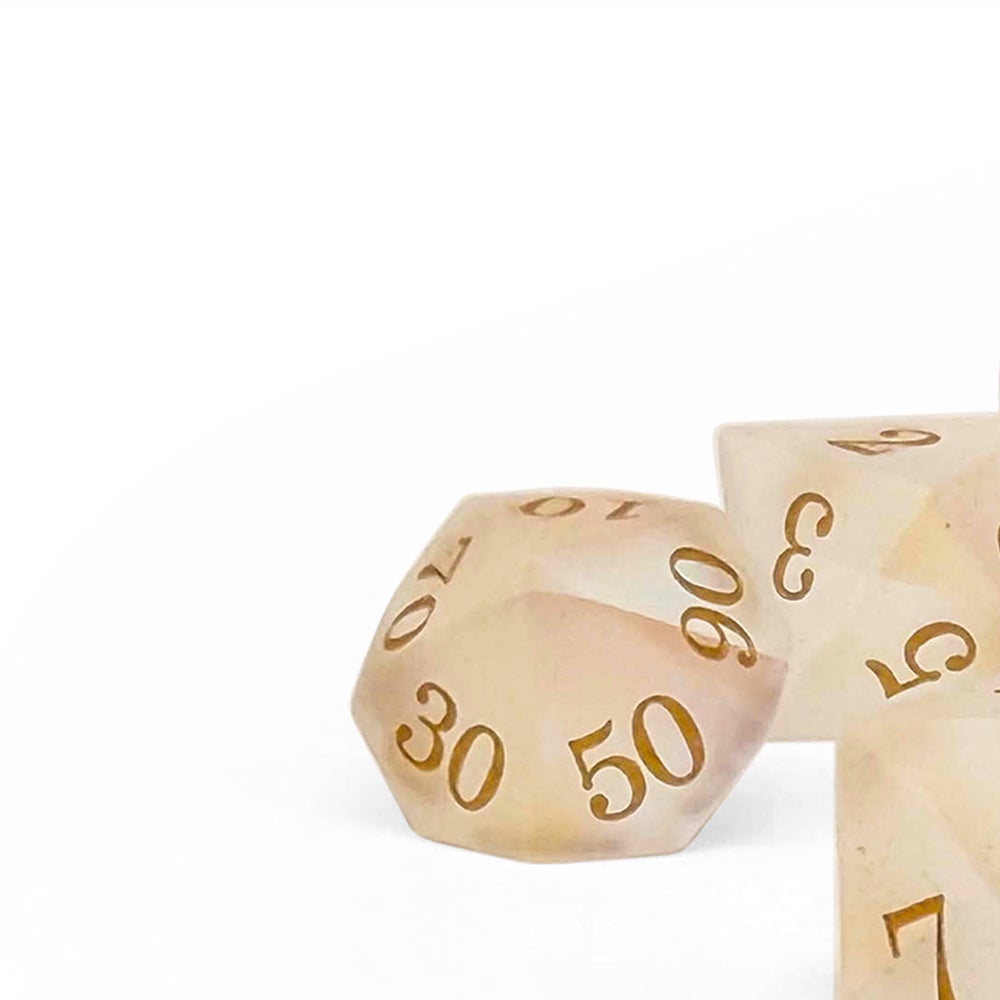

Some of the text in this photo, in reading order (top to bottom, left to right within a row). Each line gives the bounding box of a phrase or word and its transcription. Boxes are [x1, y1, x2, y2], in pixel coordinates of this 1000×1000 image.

[382, 536, 473, 652] 70
[772, 491, 835, 601] 3
[865, 621, 977, 699] 5
[394, 682, 505, 812] 30
[567, 694, 706, 821] 50
